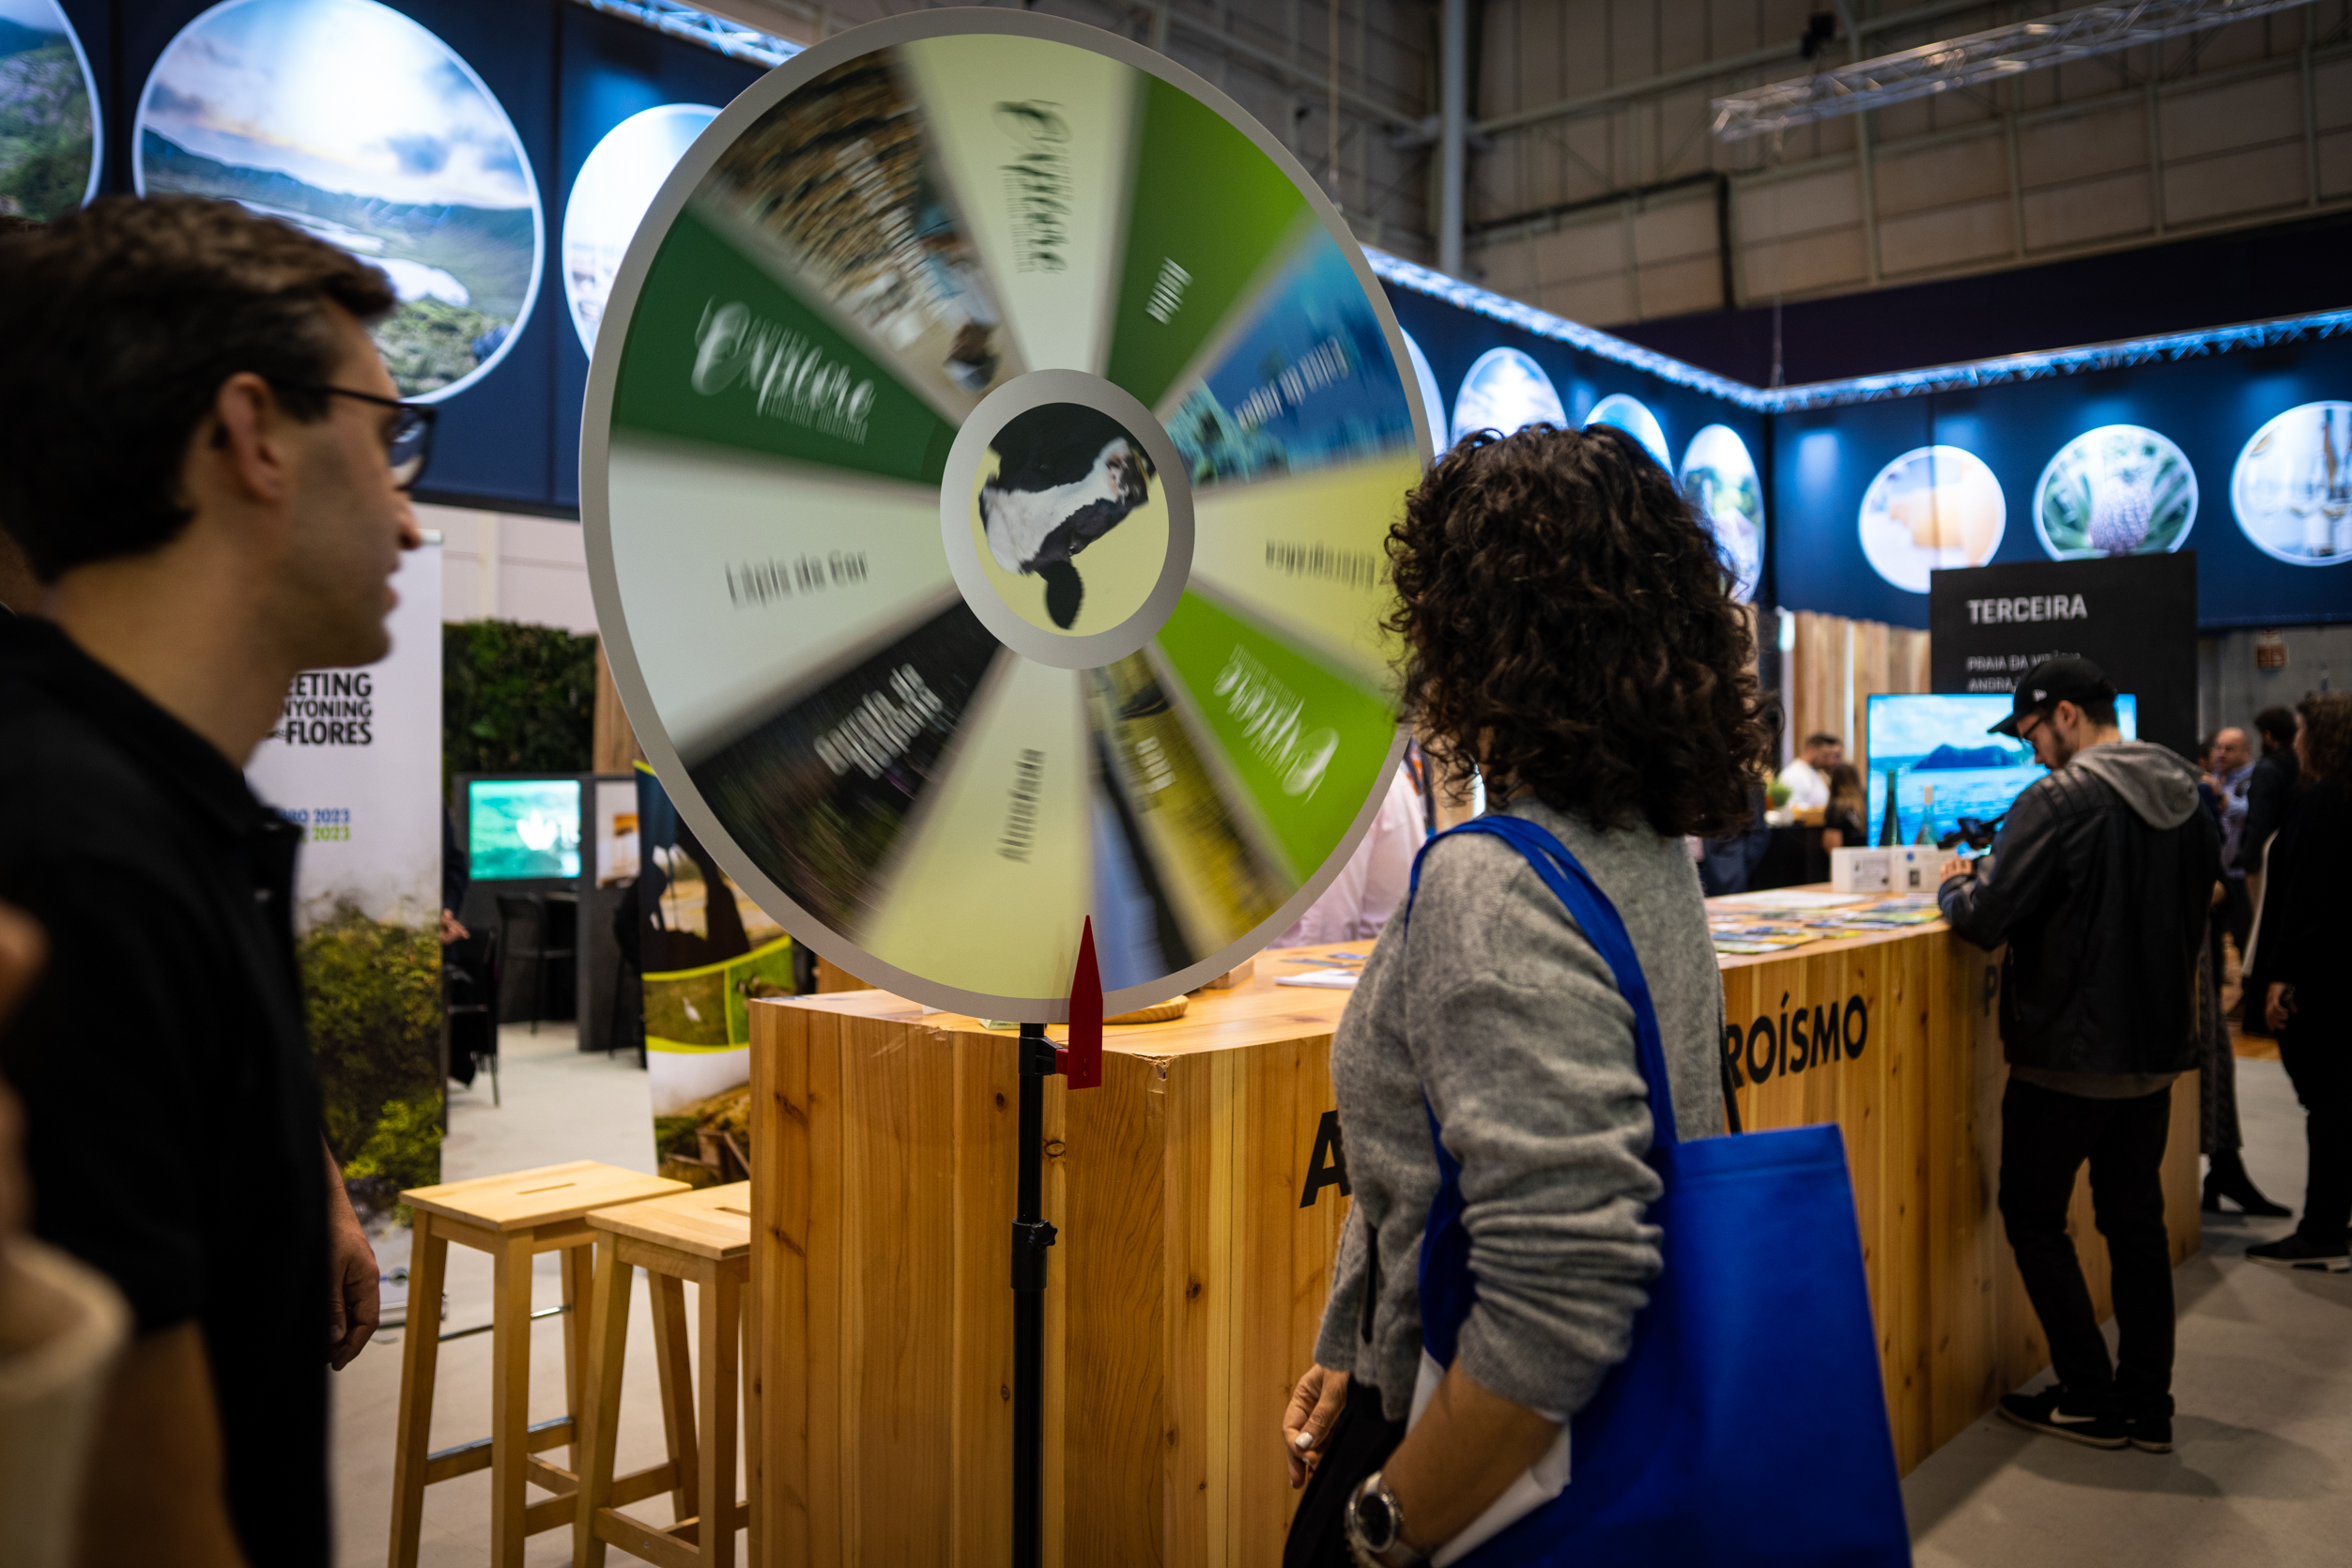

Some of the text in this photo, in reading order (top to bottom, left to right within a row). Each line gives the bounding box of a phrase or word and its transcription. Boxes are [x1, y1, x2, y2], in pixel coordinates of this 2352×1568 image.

[1967, 593, 2087, 624] TERCEIRA
[1967, 655, 2006, 671] PRAIA
[2009, 654, 2028, 670] DA
[288, 672, 372, 697] ETING
[286, 720, 372, 745] FLORES
[1726, 991, 1868, 1089] ROÍSMO
